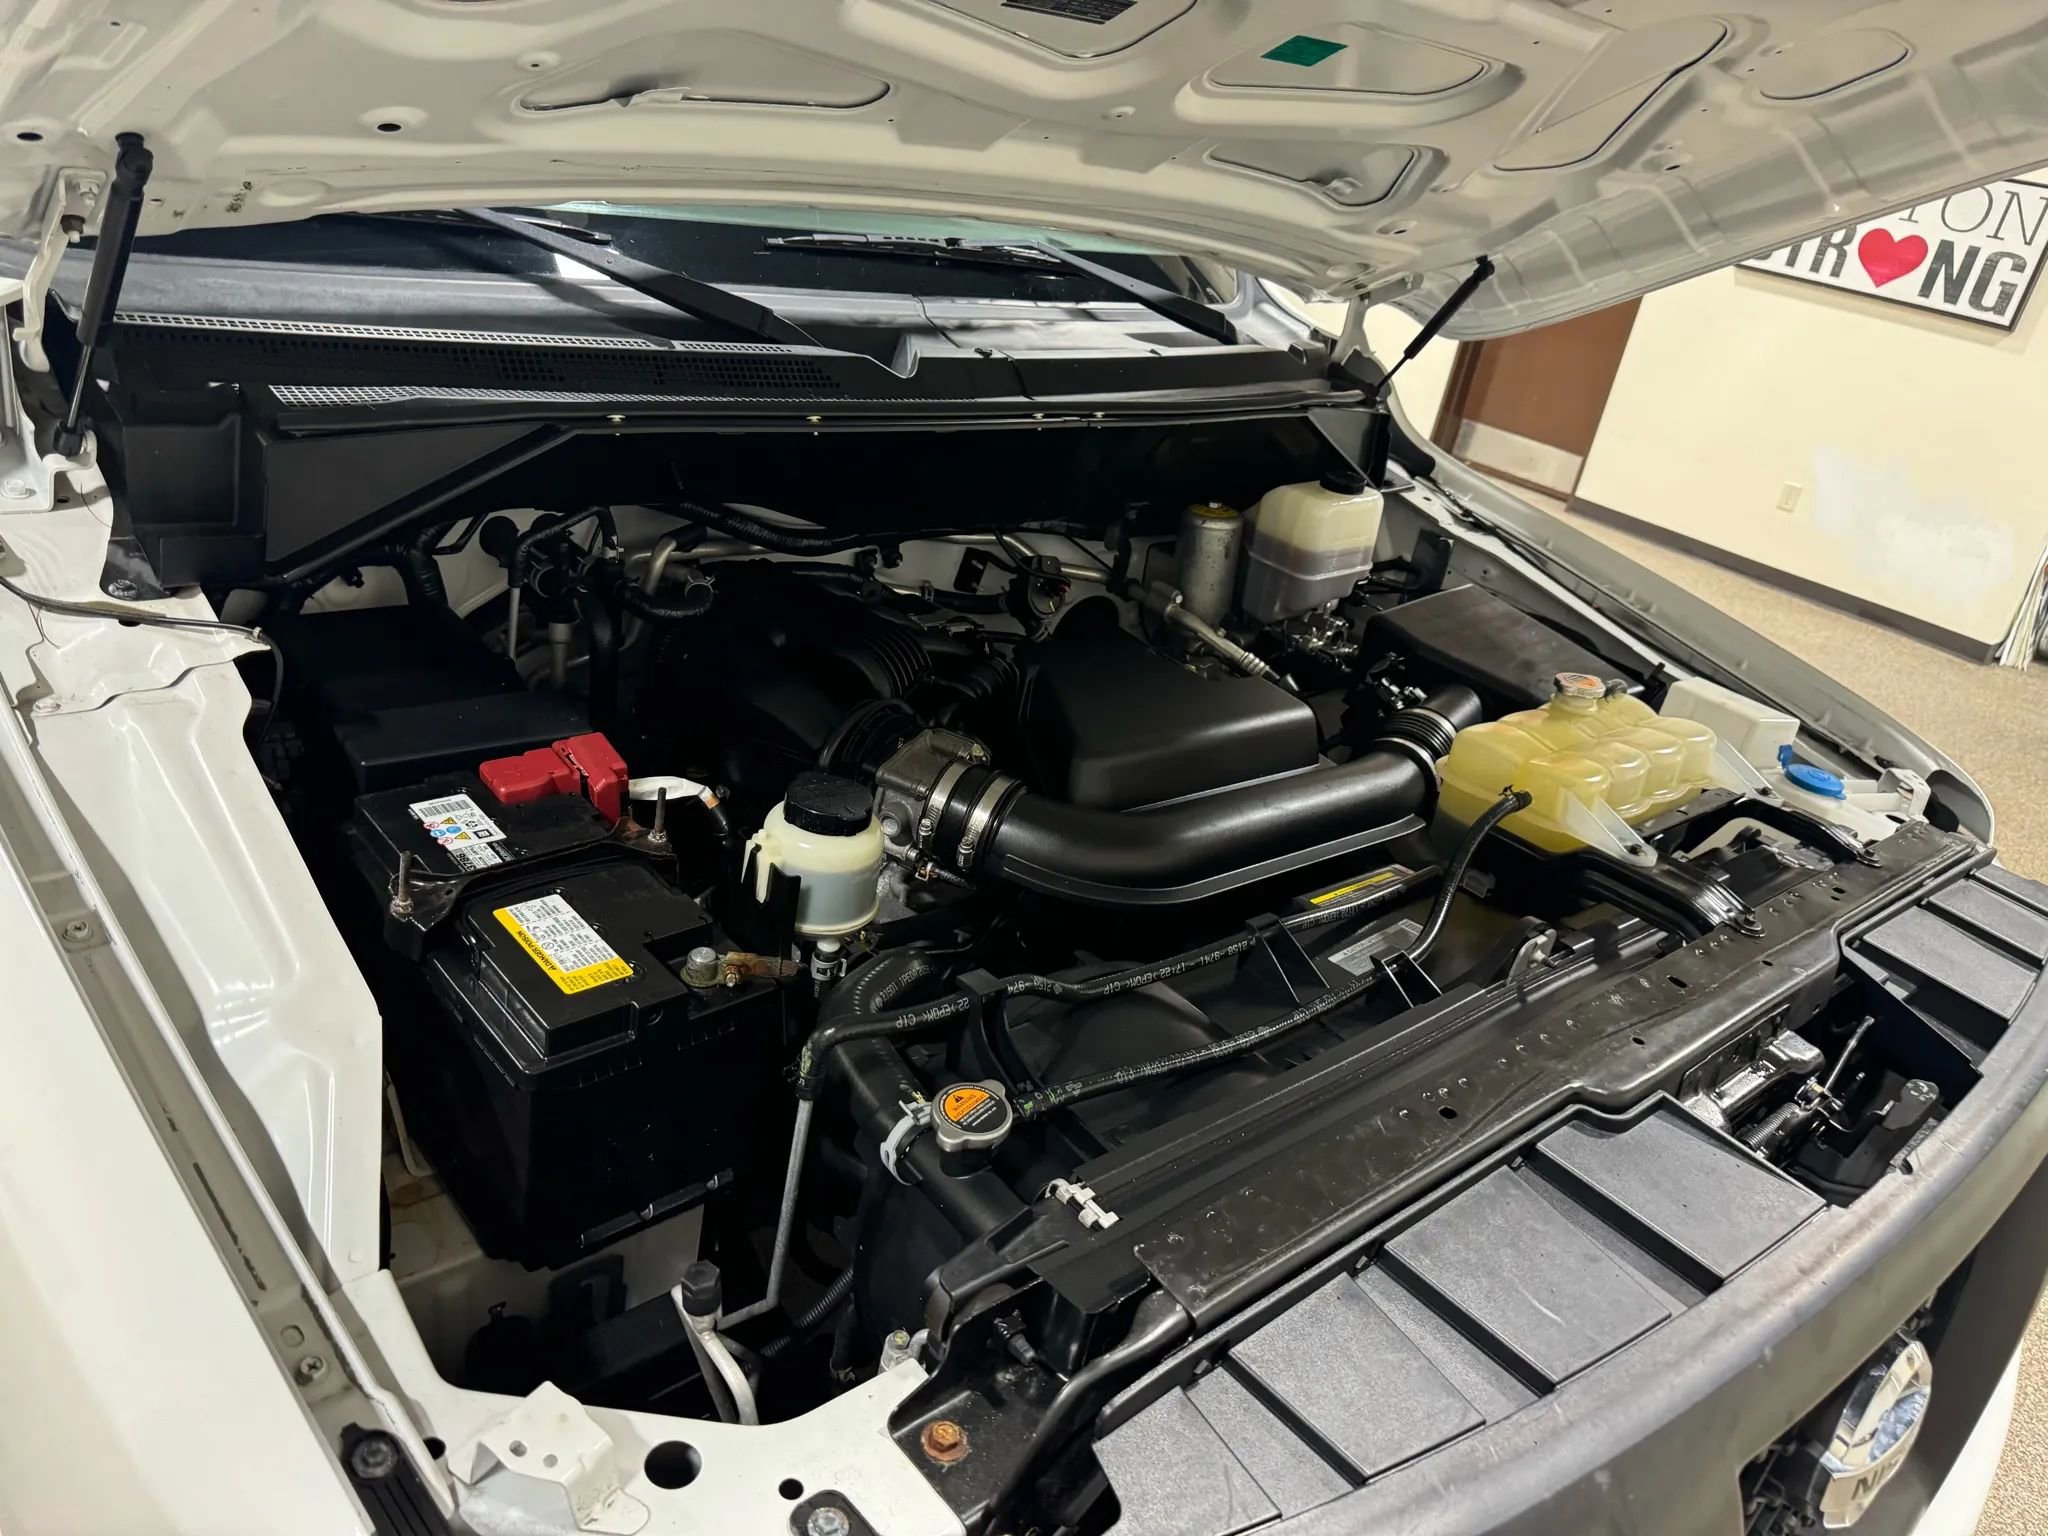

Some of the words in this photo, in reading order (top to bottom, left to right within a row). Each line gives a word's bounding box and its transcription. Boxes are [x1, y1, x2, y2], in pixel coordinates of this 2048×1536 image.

[515, 931, 536, 948] POISON
[532, 947, 552, 967] DANGER
[952, 1094, 976, 1112] WARNING
